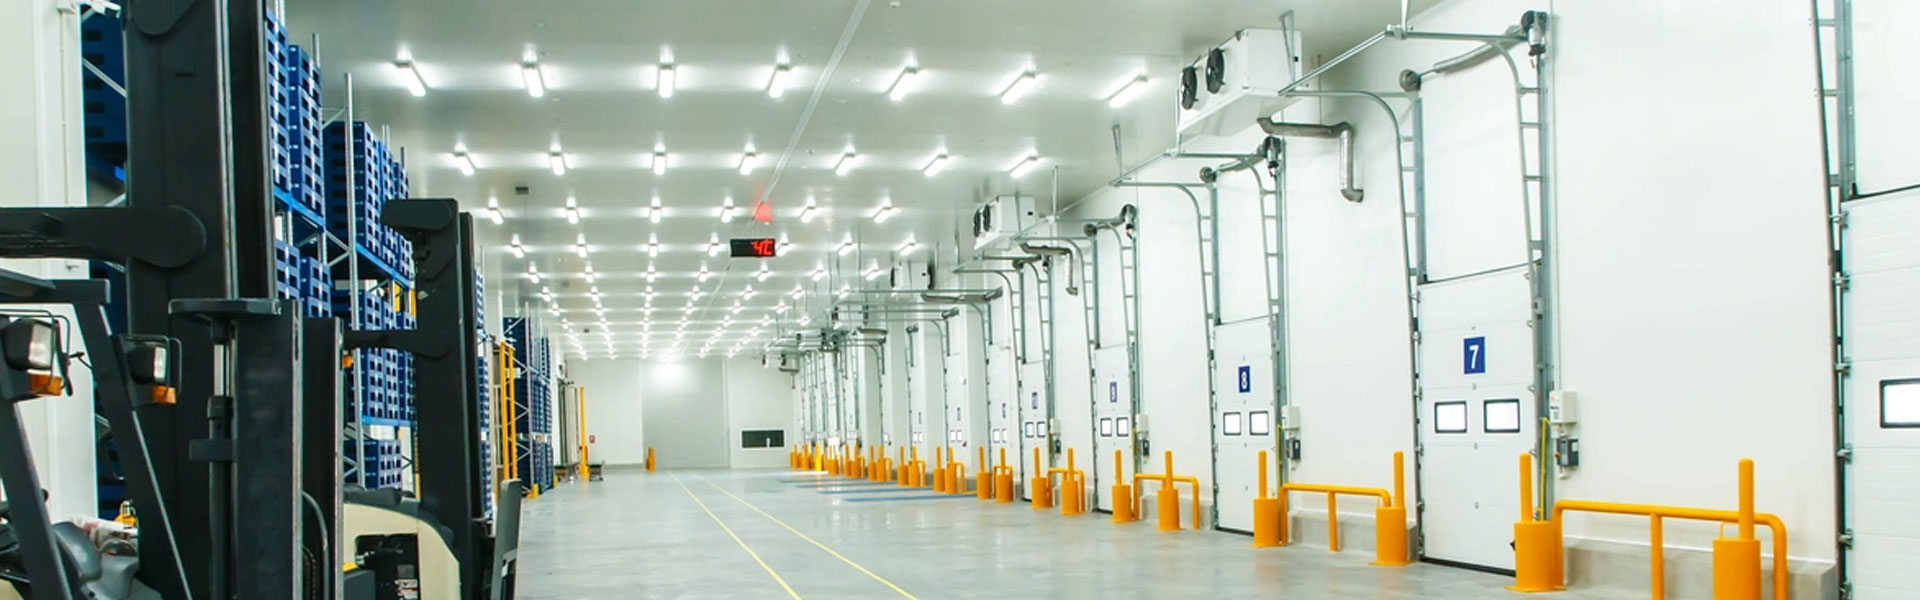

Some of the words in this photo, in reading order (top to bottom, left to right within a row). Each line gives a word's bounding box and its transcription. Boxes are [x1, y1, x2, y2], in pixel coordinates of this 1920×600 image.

[752, 240, 773, 255] 4C
[1469, 344, 1479, 369] 7
[1241, 371, 1248, 389] 8
